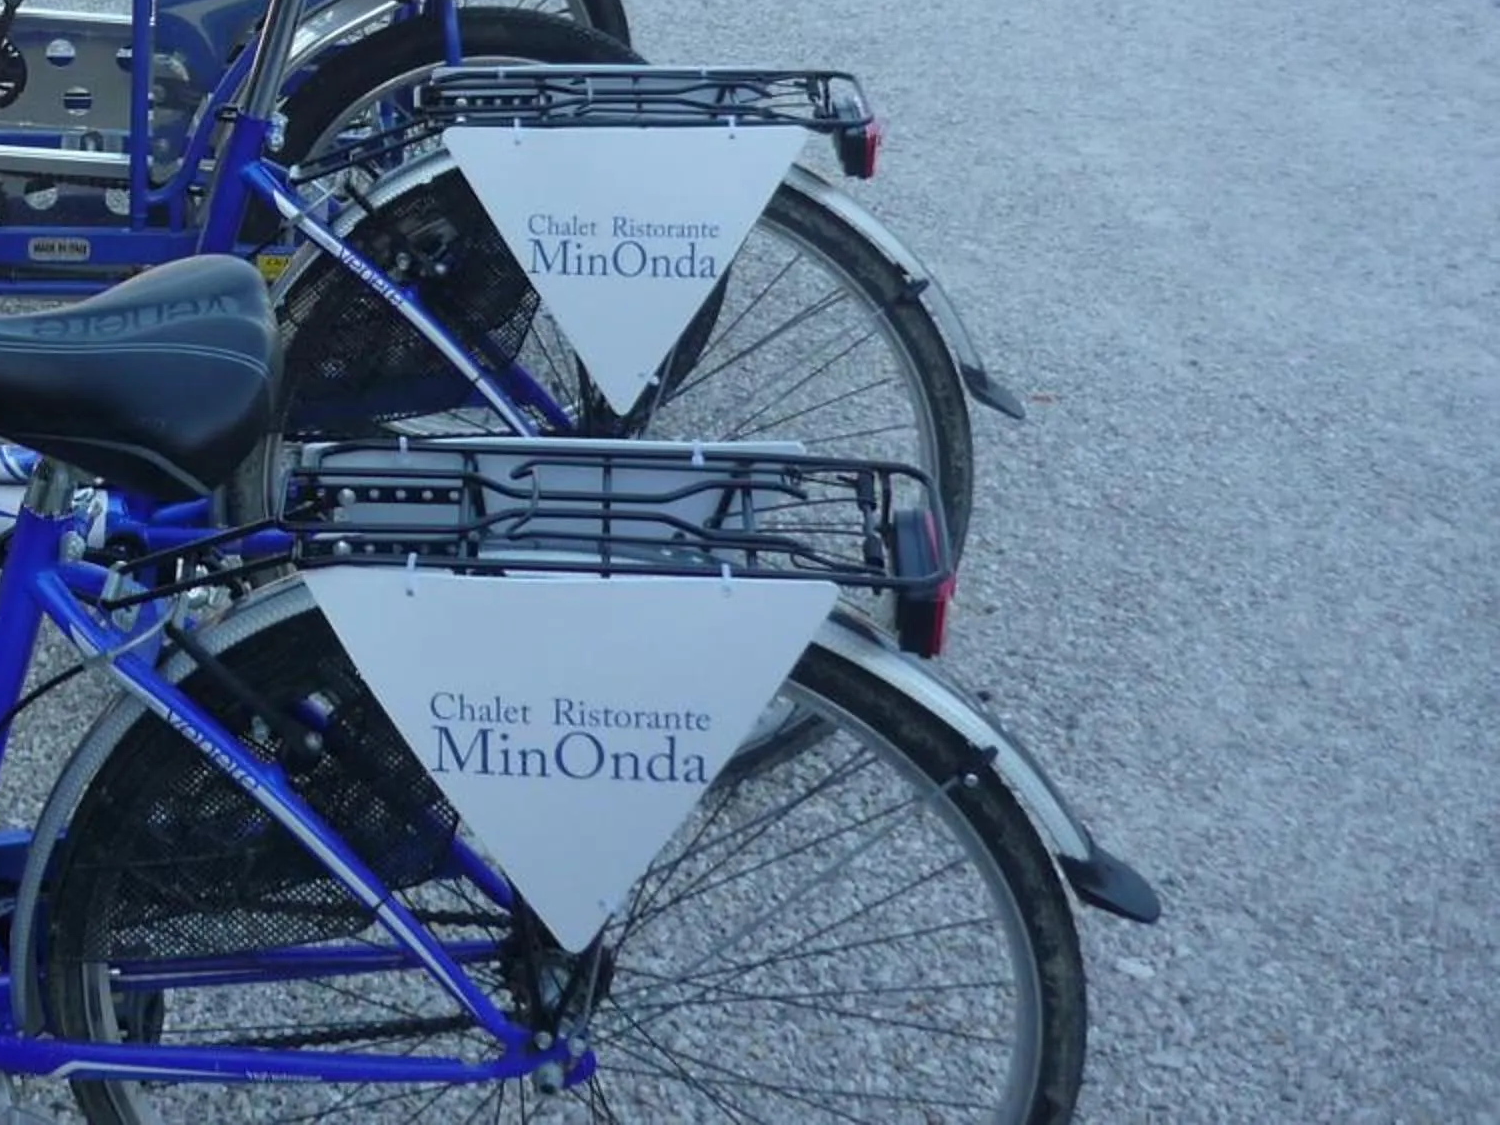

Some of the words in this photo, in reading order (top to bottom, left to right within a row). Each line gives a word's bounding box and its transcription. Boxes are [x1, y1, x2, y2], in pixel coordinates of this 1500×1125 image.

[527, 214, 597, 238] Chalet
[612, 216, 720, 239] Ristorante
[528, 238, 717, 279] MinOnda
[429, 690, 532, 725] Chalet
[553, 697, 712, 732] Ristorante
[431, 725, 708, 785] MinOnda
